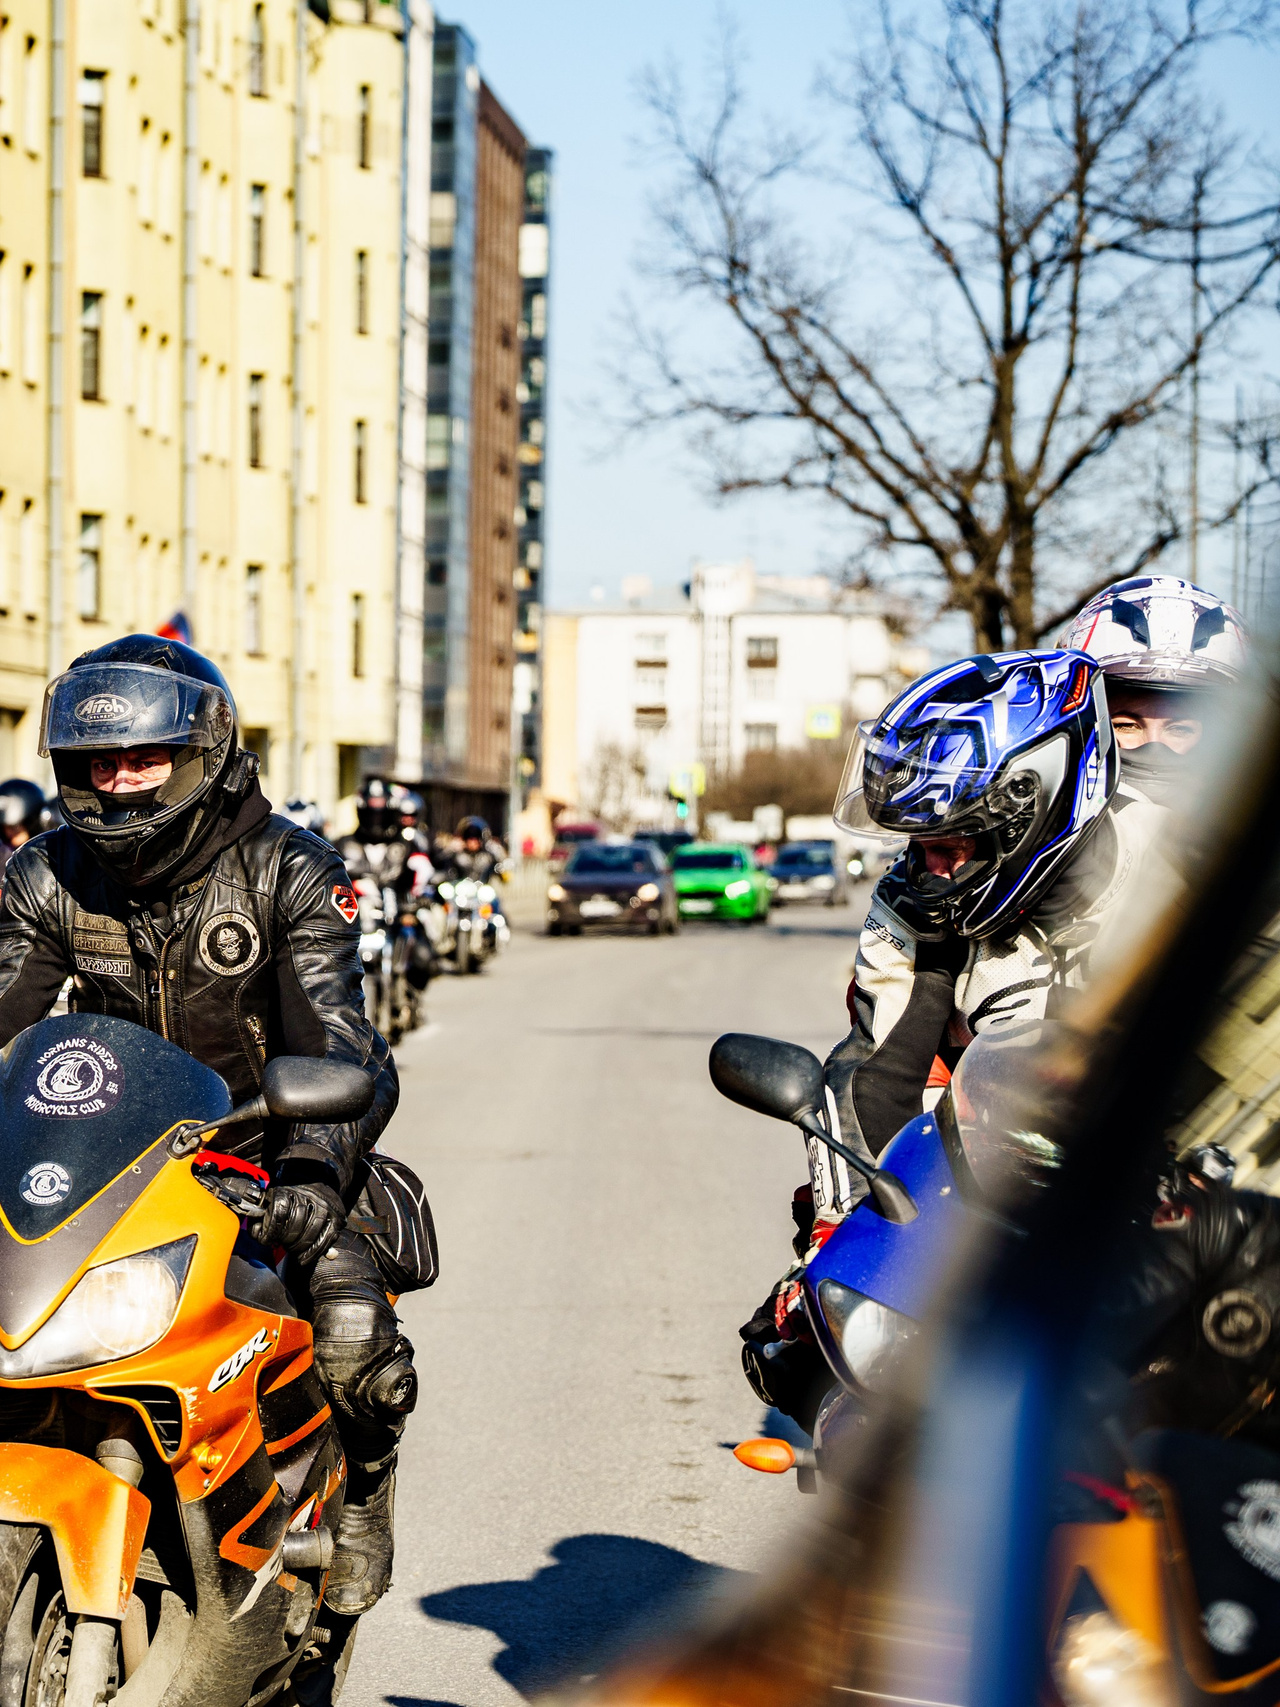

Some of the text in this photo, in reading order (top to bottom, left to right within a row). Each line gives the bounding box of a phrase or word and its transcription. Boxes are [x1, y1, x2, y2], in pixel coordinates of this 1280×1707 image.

[79, 698, 125, 715] Airoh
[36, 1038, 118, 1071] NORMANS RIDERS
[23, 1094, 107, 1116] MOTORCYCLE CLUB
[206, 1326, 274, 1394] CBR
